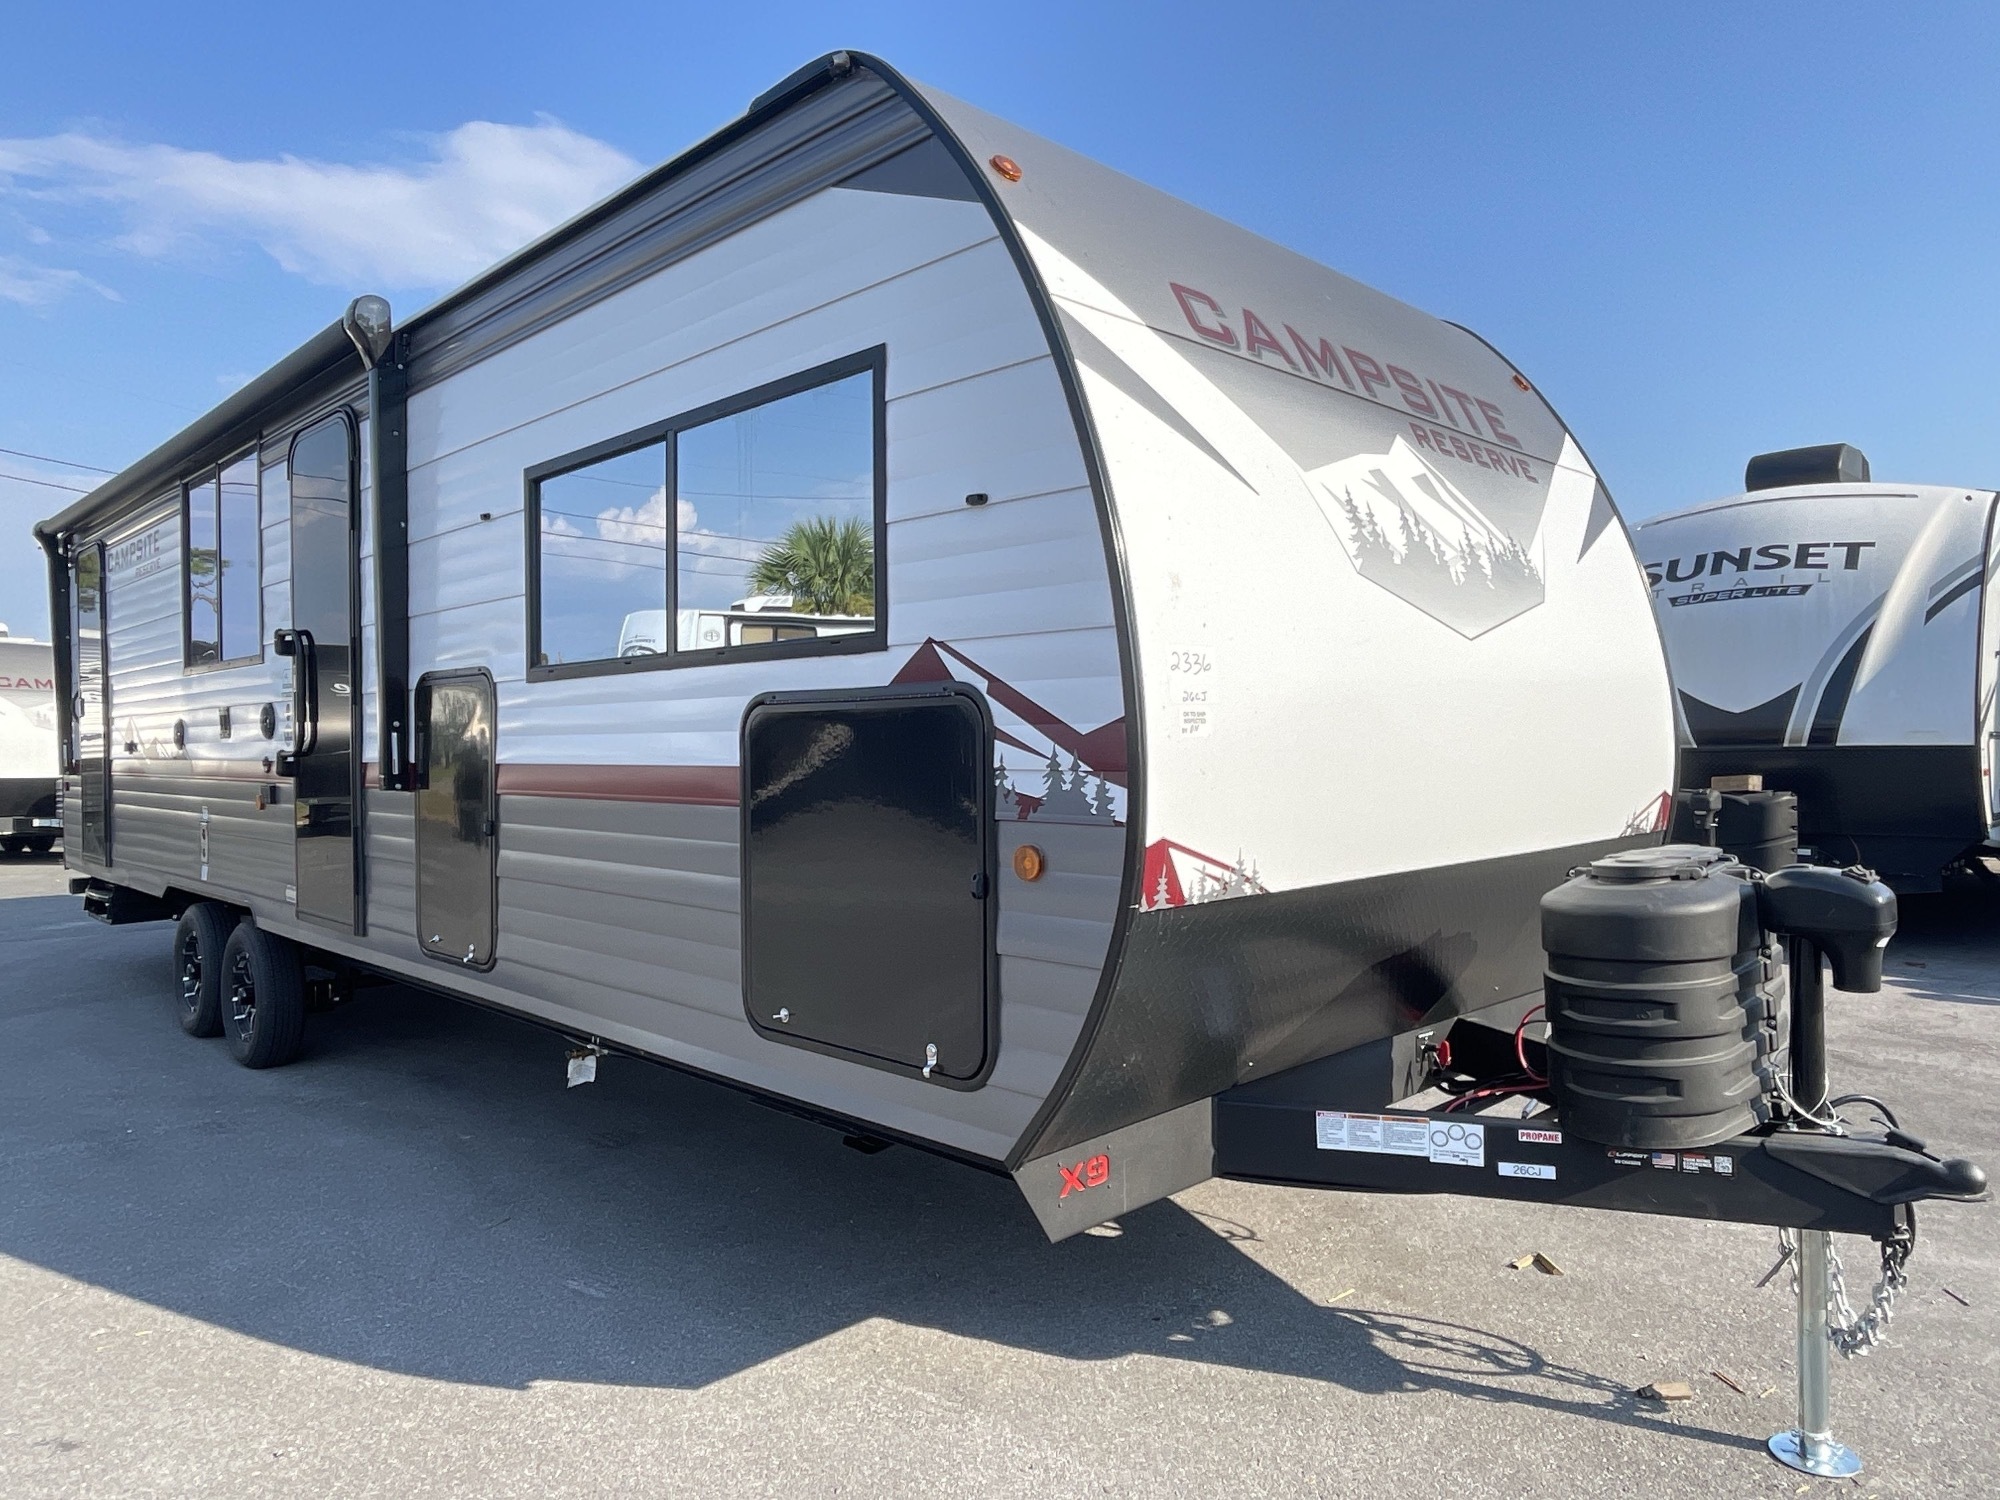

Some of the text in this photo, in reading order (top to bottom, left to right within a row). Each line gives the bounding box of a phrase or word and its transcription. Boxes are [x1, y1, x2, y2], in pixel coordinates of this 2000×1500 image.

[1169, 281, 1524, 450] CAMPSITE
[1408, 421, 1540, 484] RESERVE
[107, 529, 160, 573] CAMPSITE
[1644, 541, 1876, 588] SUNSET
[1652, 573, 1831, 599] TRAIL
[1674, 586, 1802, 607] SUPER LITE
[1170, 651, 1211, 675] 2336
[1520, 1131, 1560, 1142] PROPANE
[1059, 1154, 1110, 1199] X9
[1513, 1165, 1541, 1176] 26CJ
